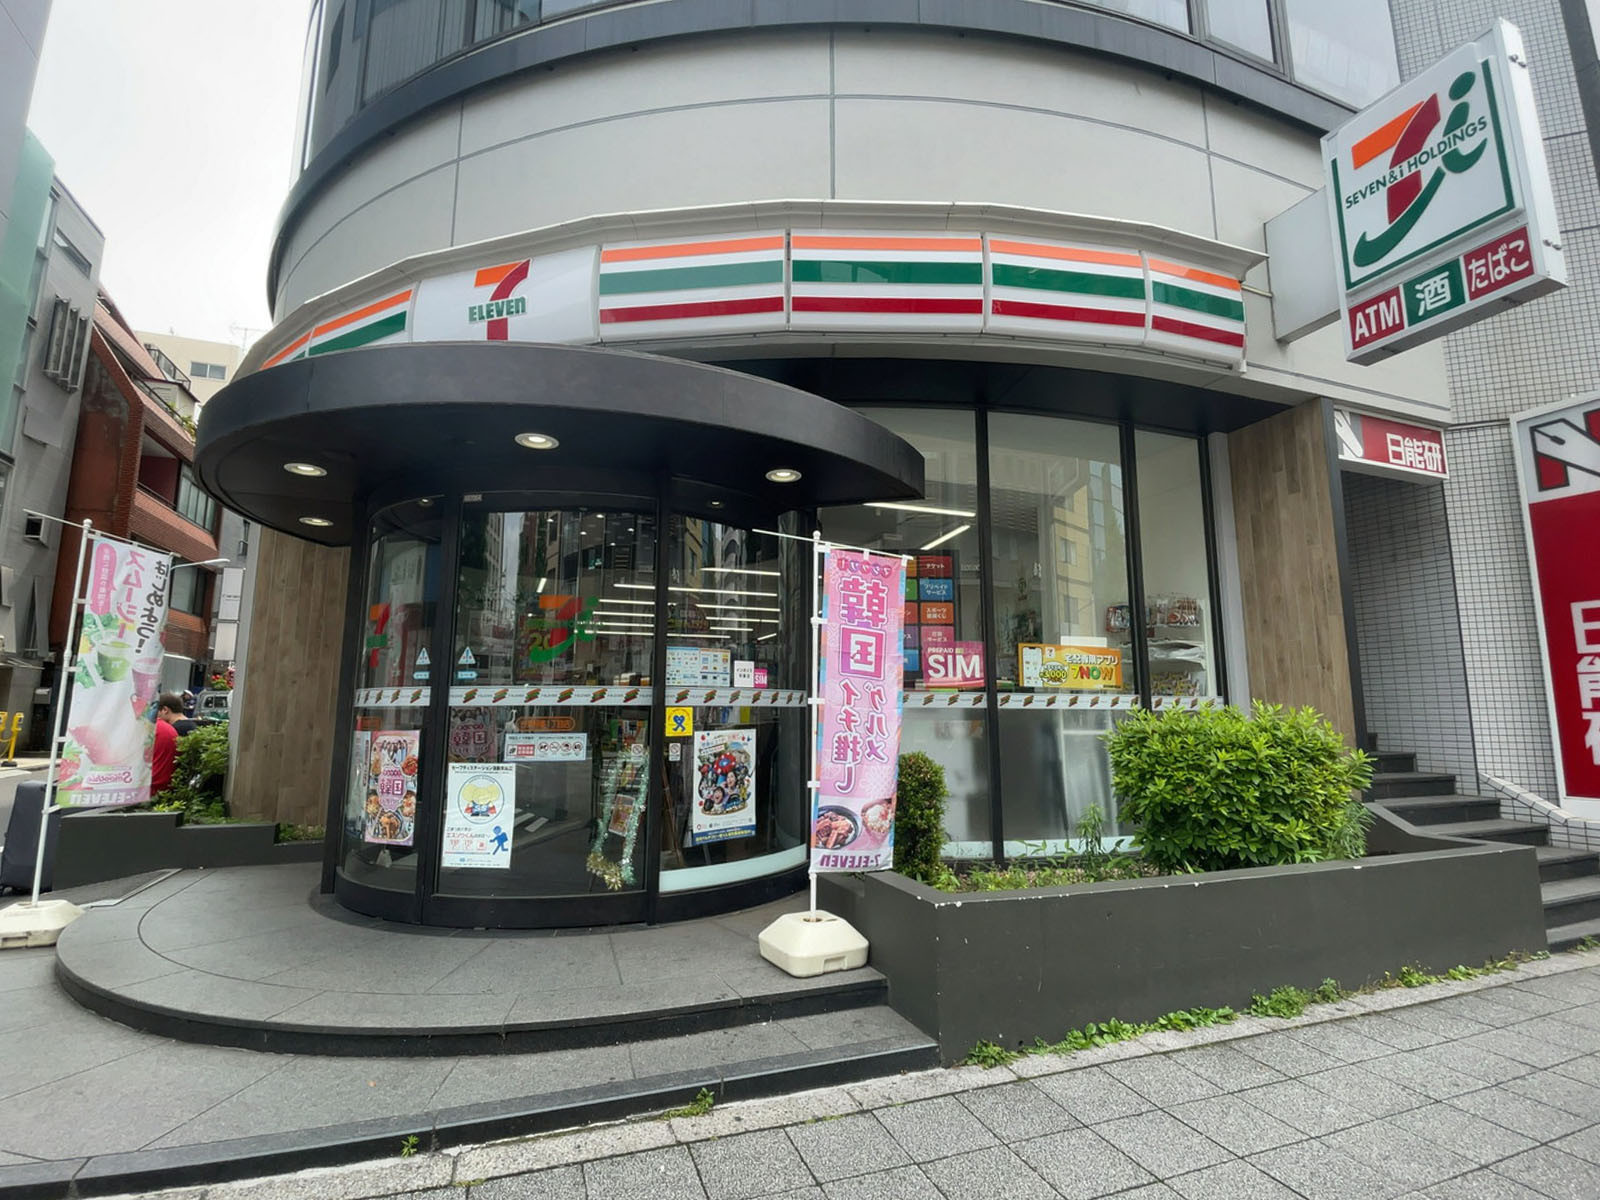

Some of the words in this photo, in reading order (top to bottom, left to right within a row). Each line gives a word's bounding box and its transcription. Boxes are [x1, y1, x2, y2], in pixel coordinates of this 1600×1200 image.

[1407, 115, 1488, 175] HOLDINGS
[1468, 239, 1531, 291] たばこ
[1415, 271, 1450, 316] 酒
[1354, 295, 1401, 342] ATM
[1386, 432, 1442, 473] 日能研
[927, 654, 981, 679] SIM
